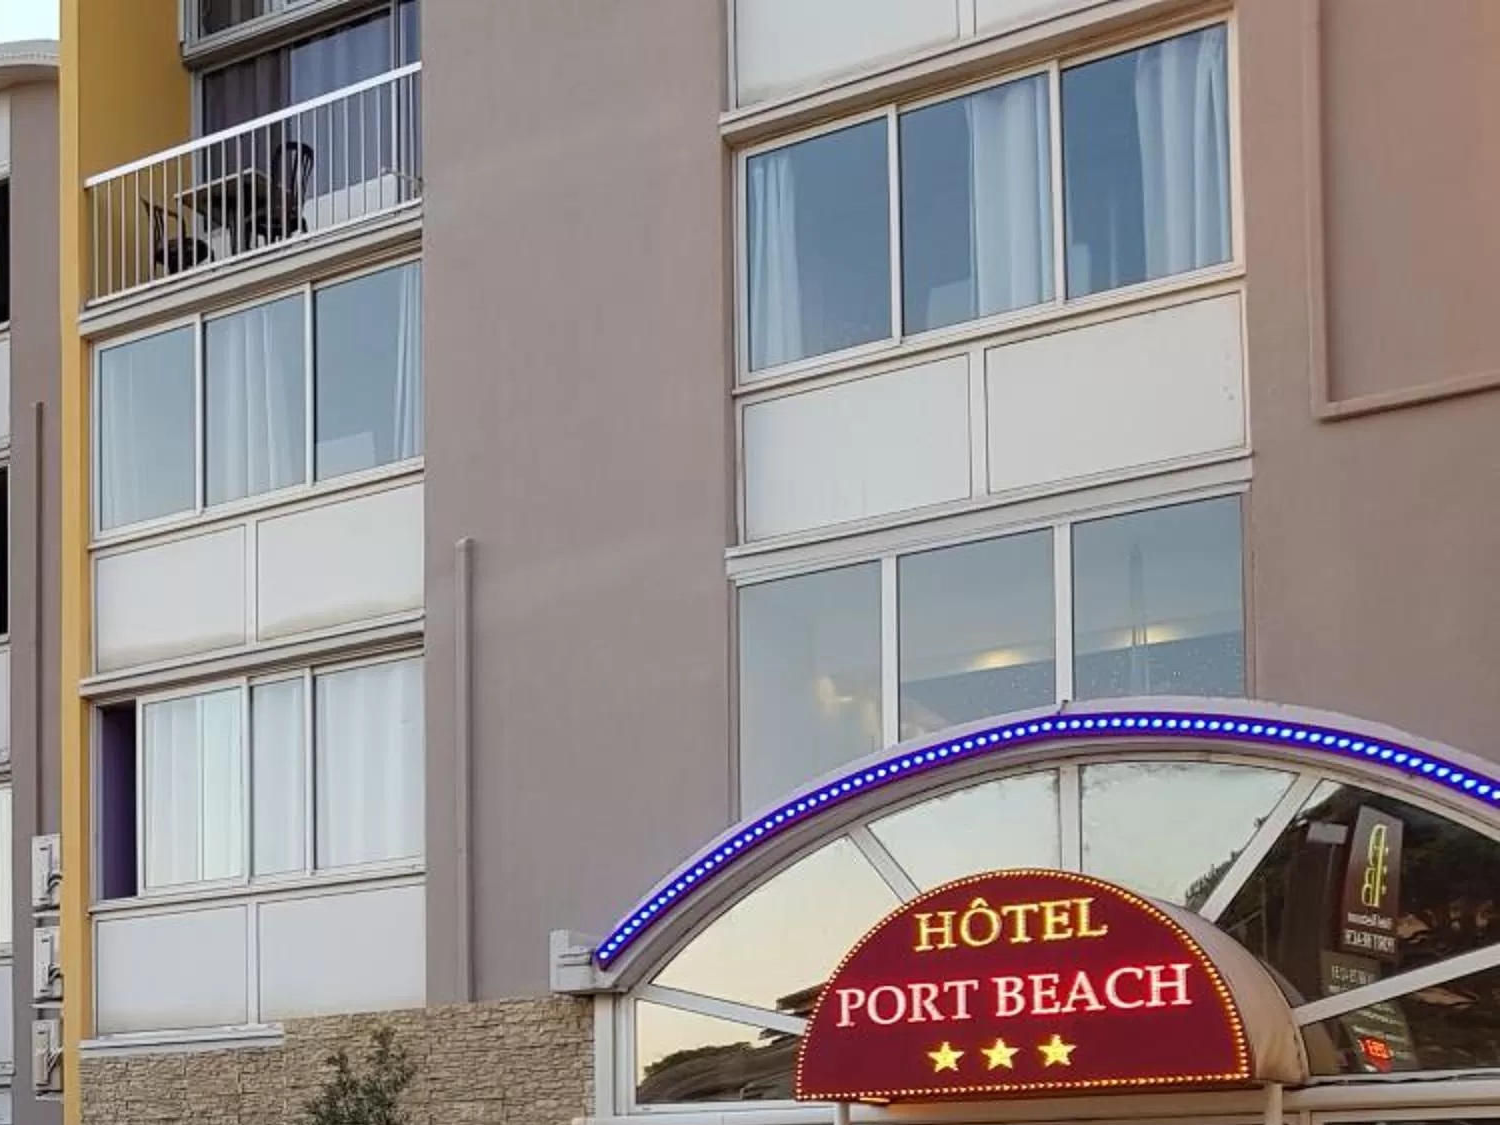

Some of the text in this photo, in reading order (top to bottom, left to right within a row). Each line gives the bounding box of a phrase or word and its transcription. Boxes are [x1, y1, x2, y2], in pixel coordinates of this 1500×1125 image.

[913, 896, 1109, 952] HÔTEL
[835, 962, 1194, 1028] PORT BEACH
